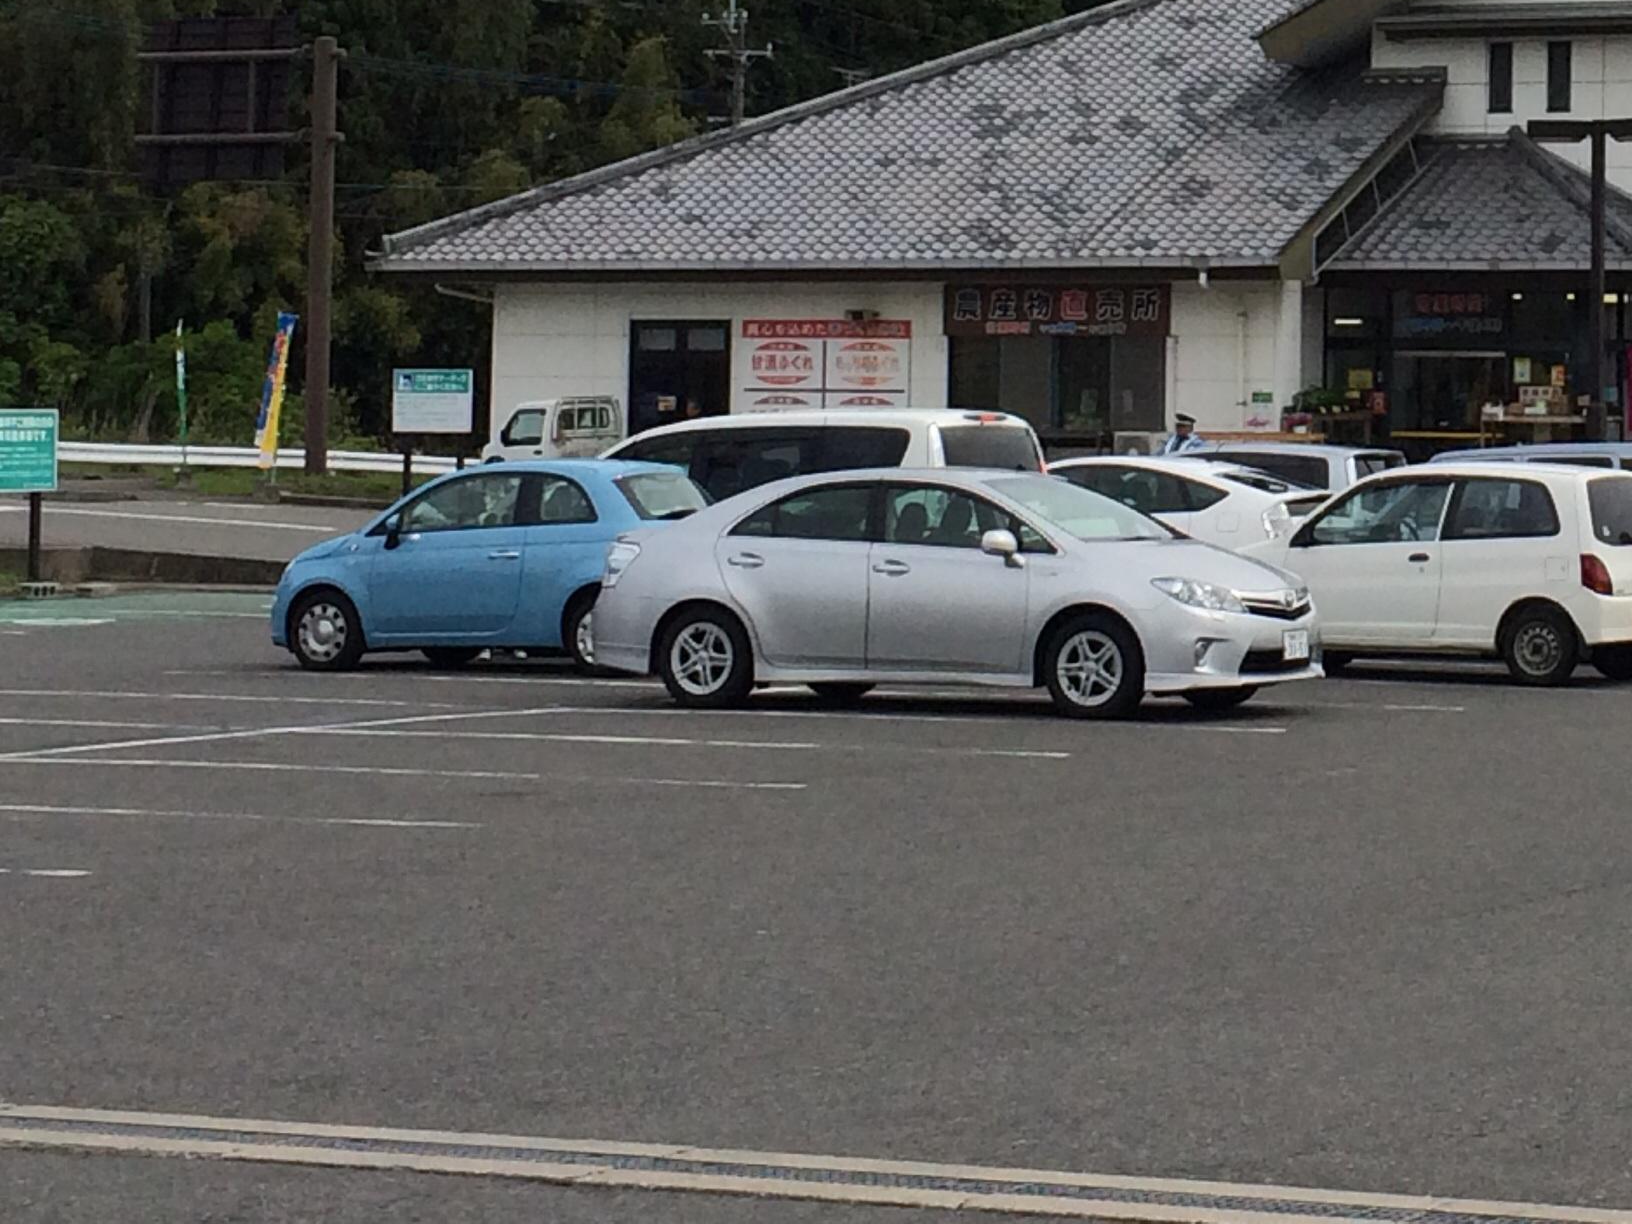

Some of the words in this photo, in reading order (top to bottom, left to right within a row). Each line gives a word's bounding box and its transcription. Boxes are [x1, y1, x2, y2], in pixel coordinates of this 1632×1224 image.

[954, 288, 1160, 321] 農産物直売所
